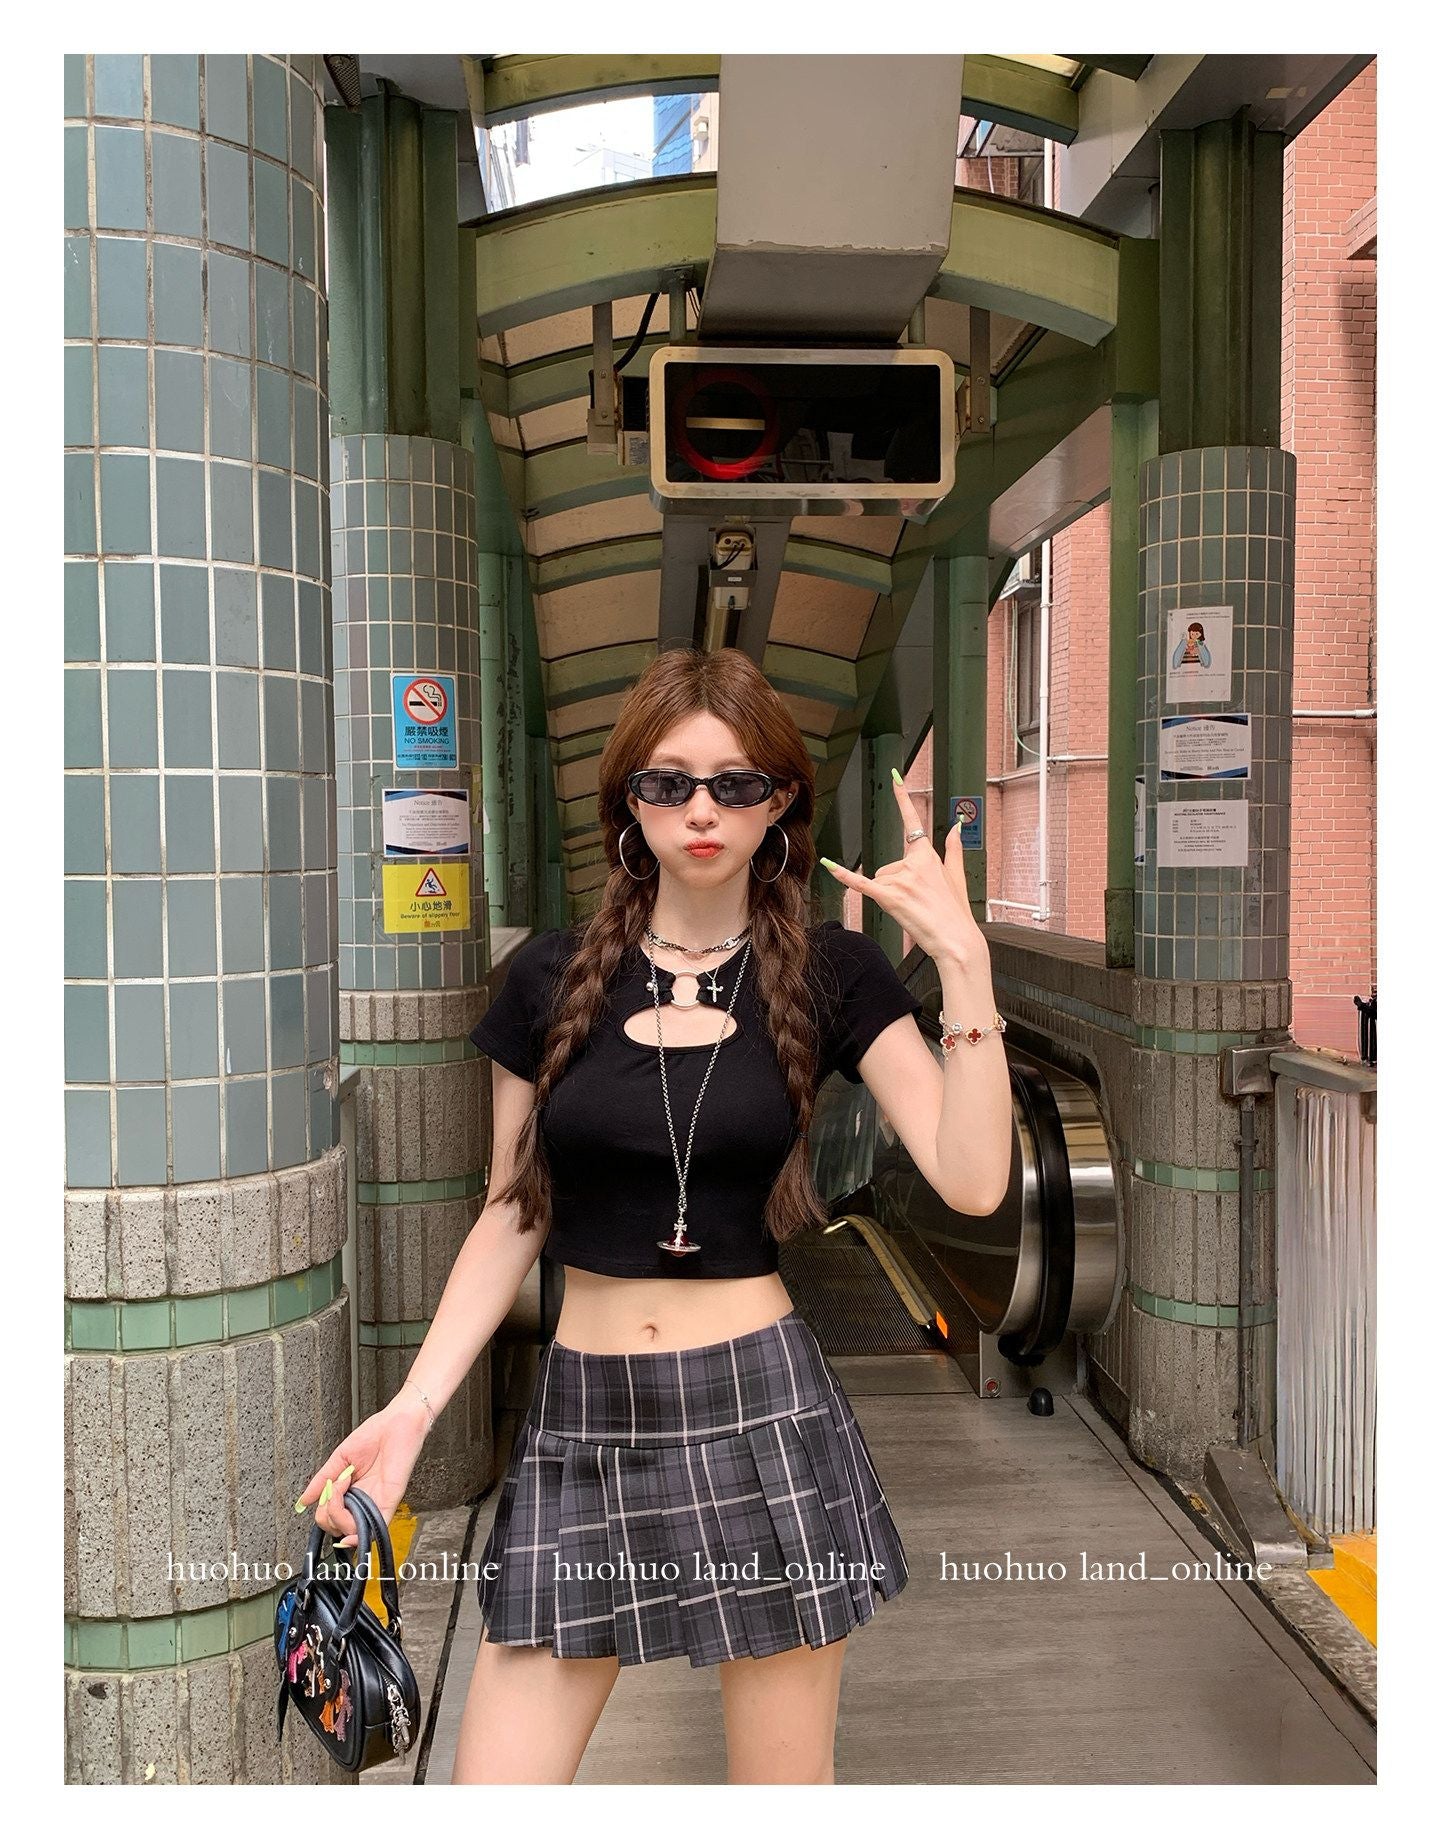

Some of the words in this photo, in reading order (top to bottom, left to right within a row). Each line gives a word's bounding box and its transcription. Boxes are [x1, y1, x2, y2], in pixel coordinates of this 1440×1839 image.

[404, 726, 449, 736] 嚴禁吸煙
[410, 900, 453, 912] 小心地滑
